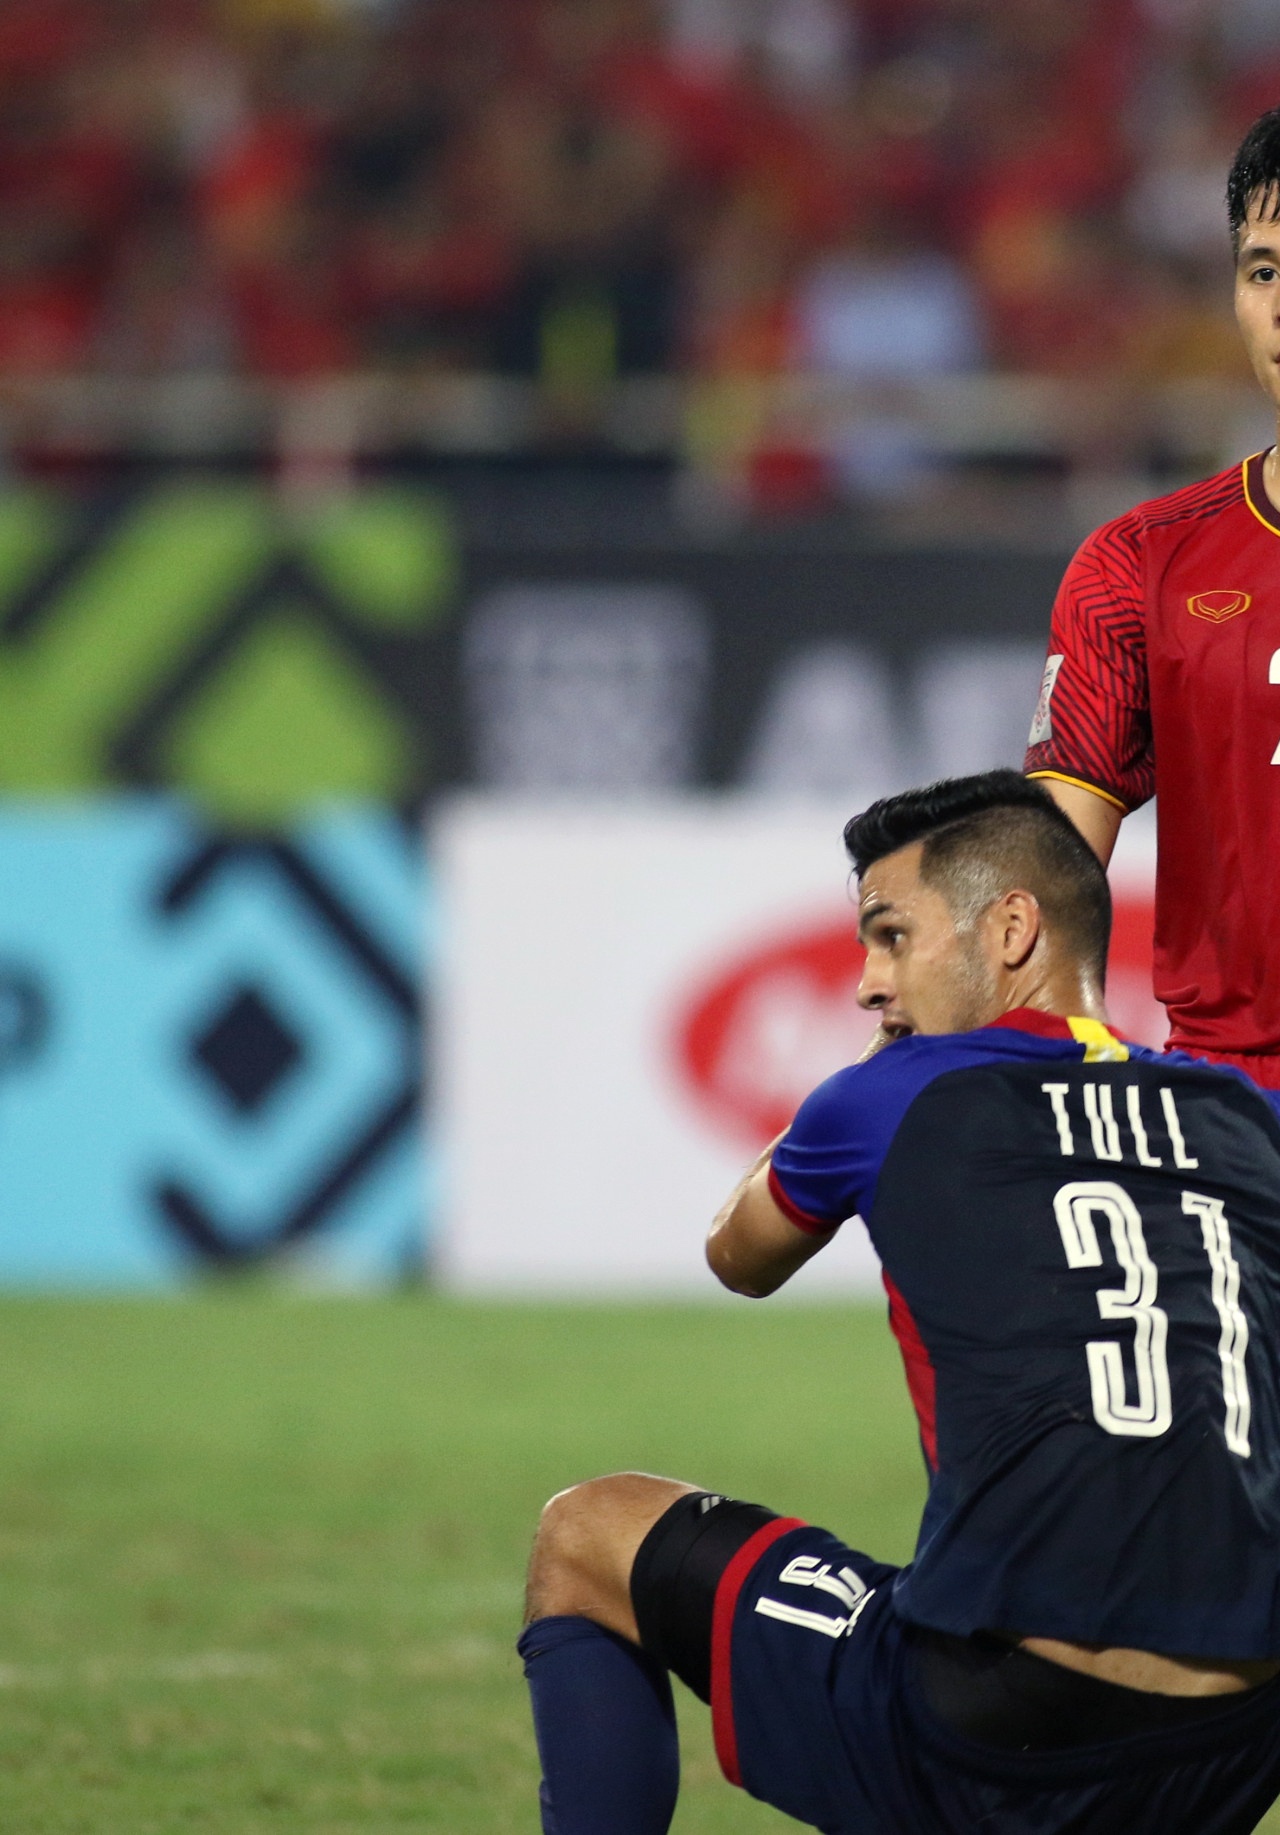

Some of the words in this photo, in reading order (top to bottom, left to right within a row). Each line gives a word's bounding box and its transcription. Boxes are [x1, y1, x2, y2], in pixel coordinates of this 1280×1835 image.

[1041, 1083, 1199, 1169] TULL
[1053, 1180, 1251, 1458] 31
[754, 1554, 876, 1639] 31
